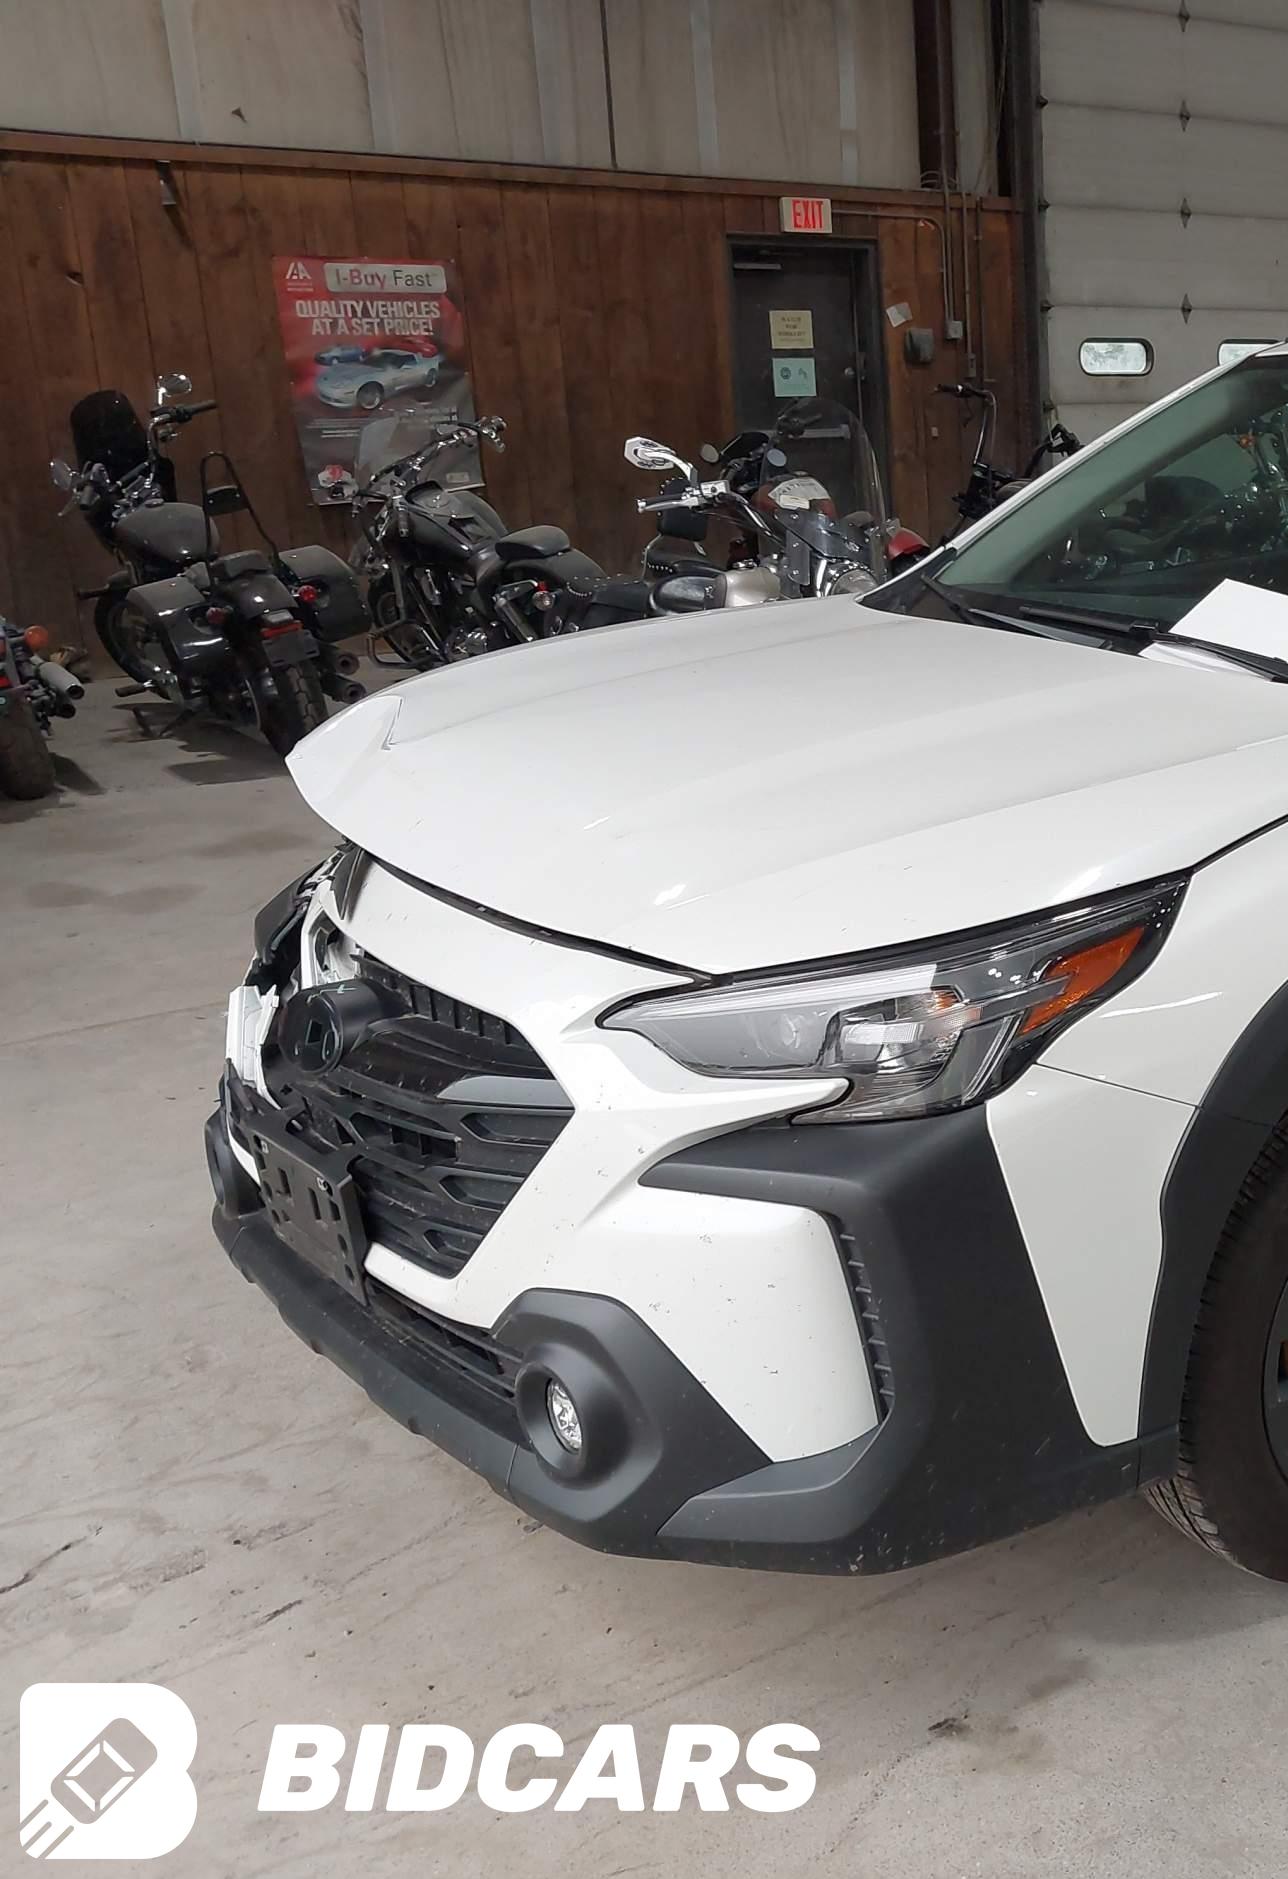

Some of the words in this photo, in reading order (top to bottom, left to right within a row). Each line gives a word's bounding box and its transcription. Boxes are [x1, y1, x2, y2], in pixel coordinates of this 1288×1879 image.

[792, 199, 824, 229] EXIT
[335, 268, 387, 290] I-Buy
[295, 300, 363, 318] QUALITY
[363, 301, 441, 319] VEHICLES
[311, 318, 333, 336] AT
[336, 319, 350, 336] A
[352, 318, 382, 337] SET
[384, 319, 434, 337] PRICE!
